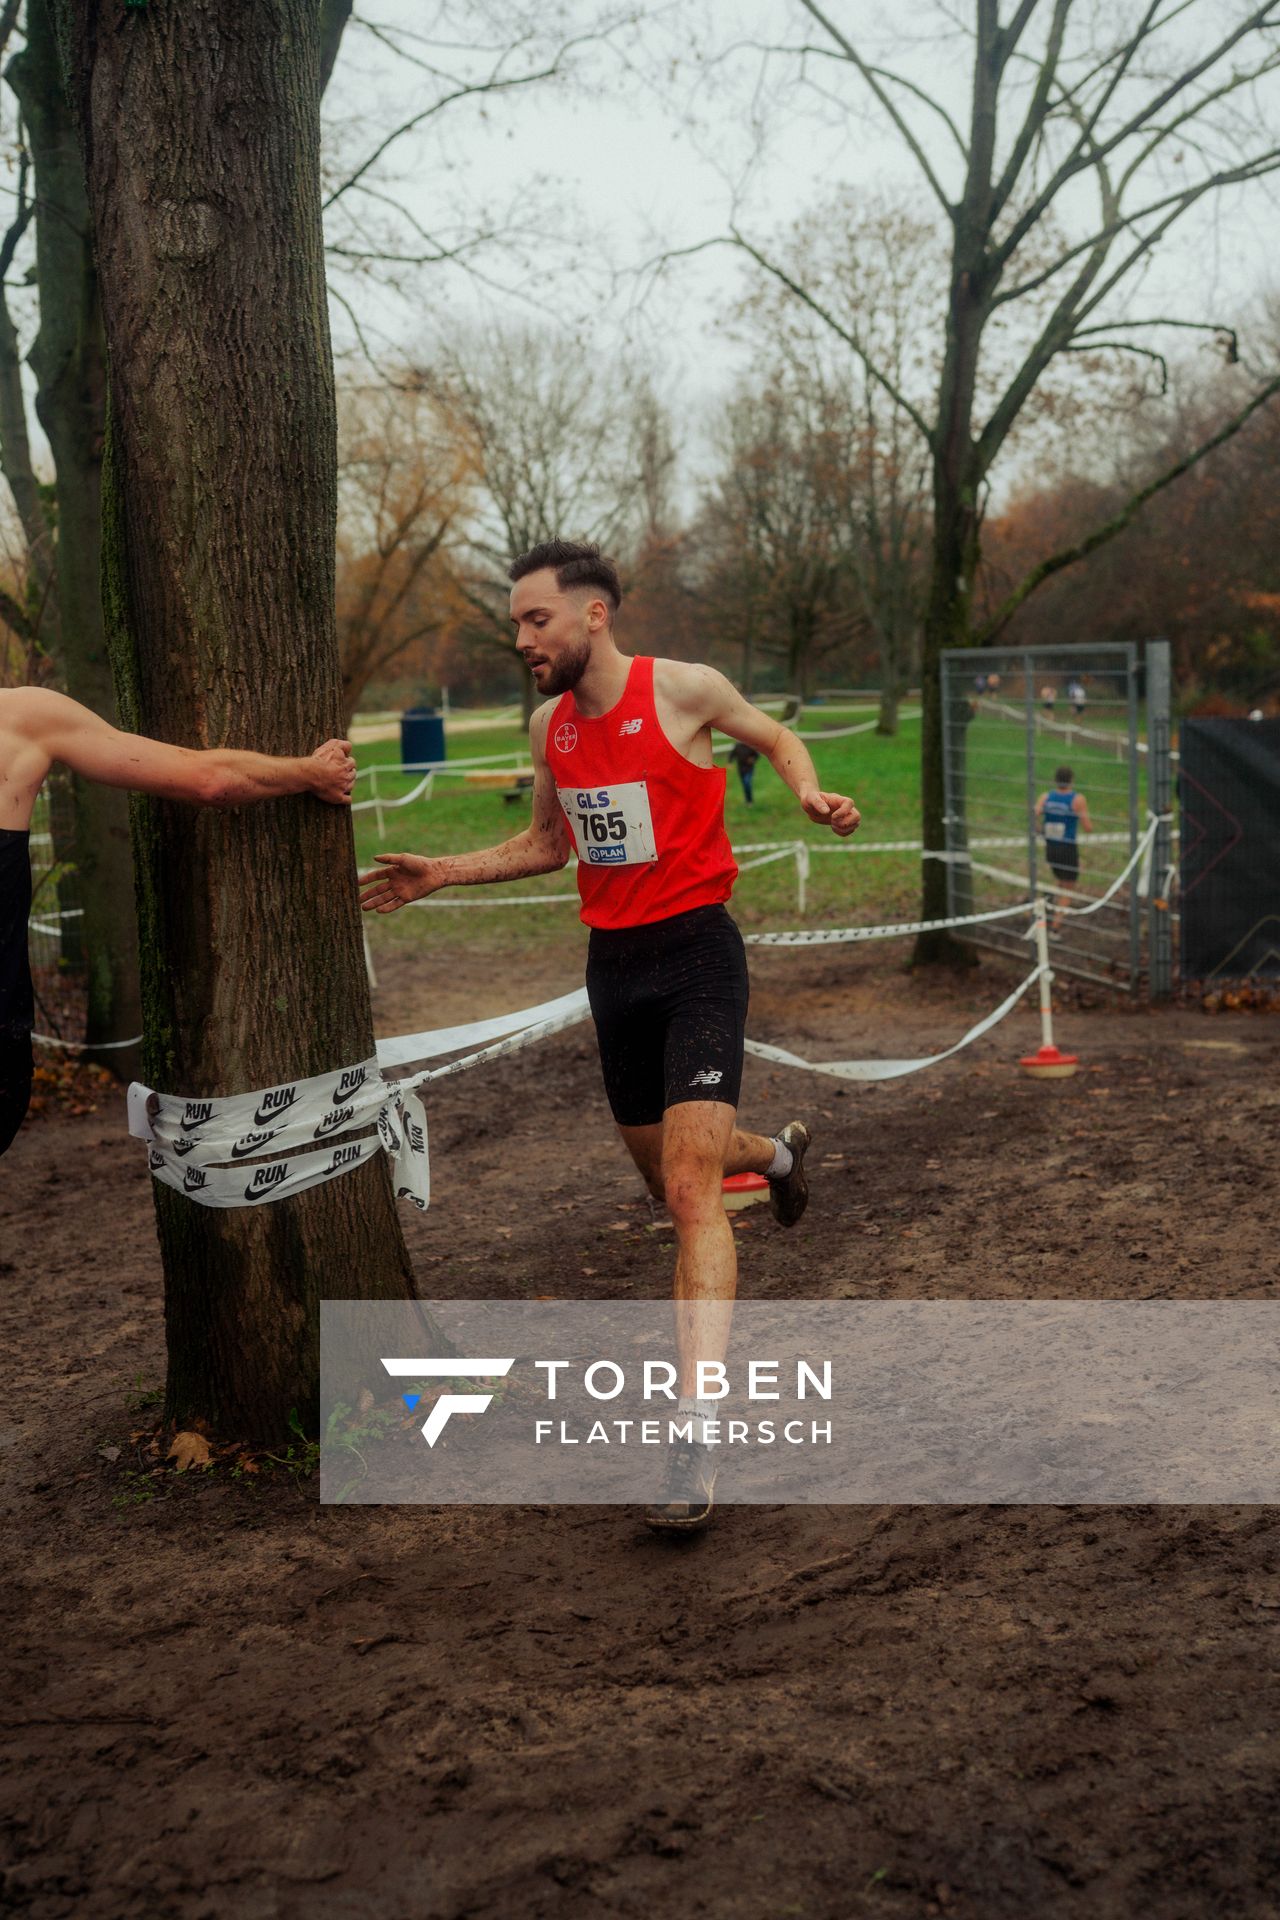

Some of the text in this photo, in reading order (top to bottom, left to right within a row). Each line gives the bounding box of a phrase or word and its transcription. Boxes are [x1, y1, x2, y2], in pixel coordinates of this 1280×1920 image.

[577, 810, 627, 842] 765
[600, 847, 624, 858] PLAN
[340, 1066, 366, 1089] RUN
[262, 1086, 296, 1110] RUN
[185, 1103, 213, 1120] RUN
[322, 1105, 354, 1127] RUN
[412, 1124, 425, 1154] RUN
[332, 1144, 361, 1168] RUN
[186, 1166, 206, 1185] RUN
[253, 1164, 288, 1187] RUN
